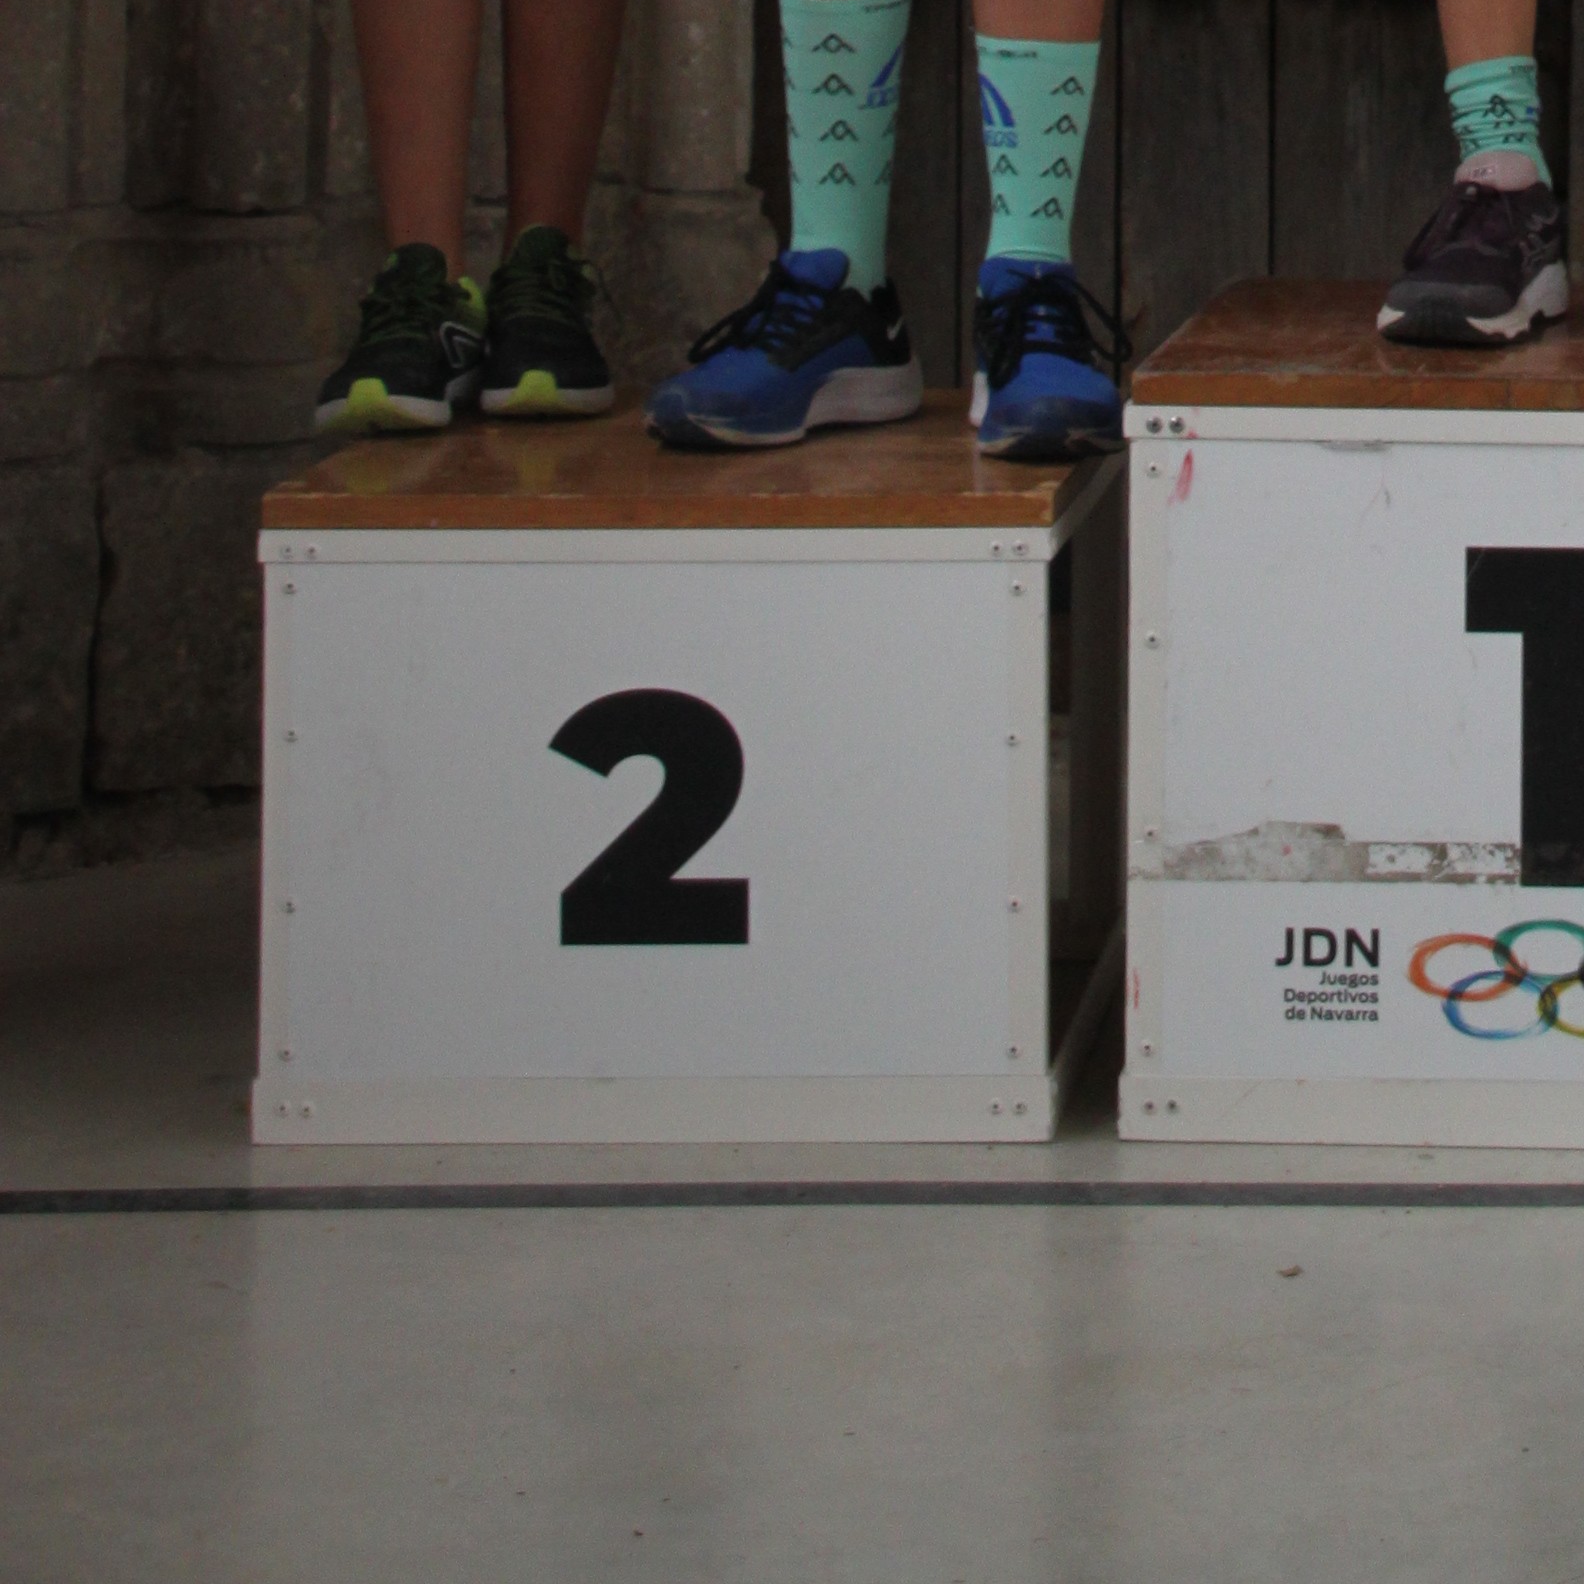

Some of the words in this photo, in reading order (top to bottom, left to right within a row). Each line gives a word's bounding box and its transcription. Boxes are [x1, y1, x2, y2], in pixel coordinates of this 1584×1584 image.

[548, 687, 749, 946] 2
[1275, 927, 1380, 967] JDN
[1319, 971, 1379, 988] Juegos
[1284, 988, 1379, 1005] Deportivos
[1285, 1006, 1305, 1020] de
[1310, 1006, 1379, 1021] Navarra
